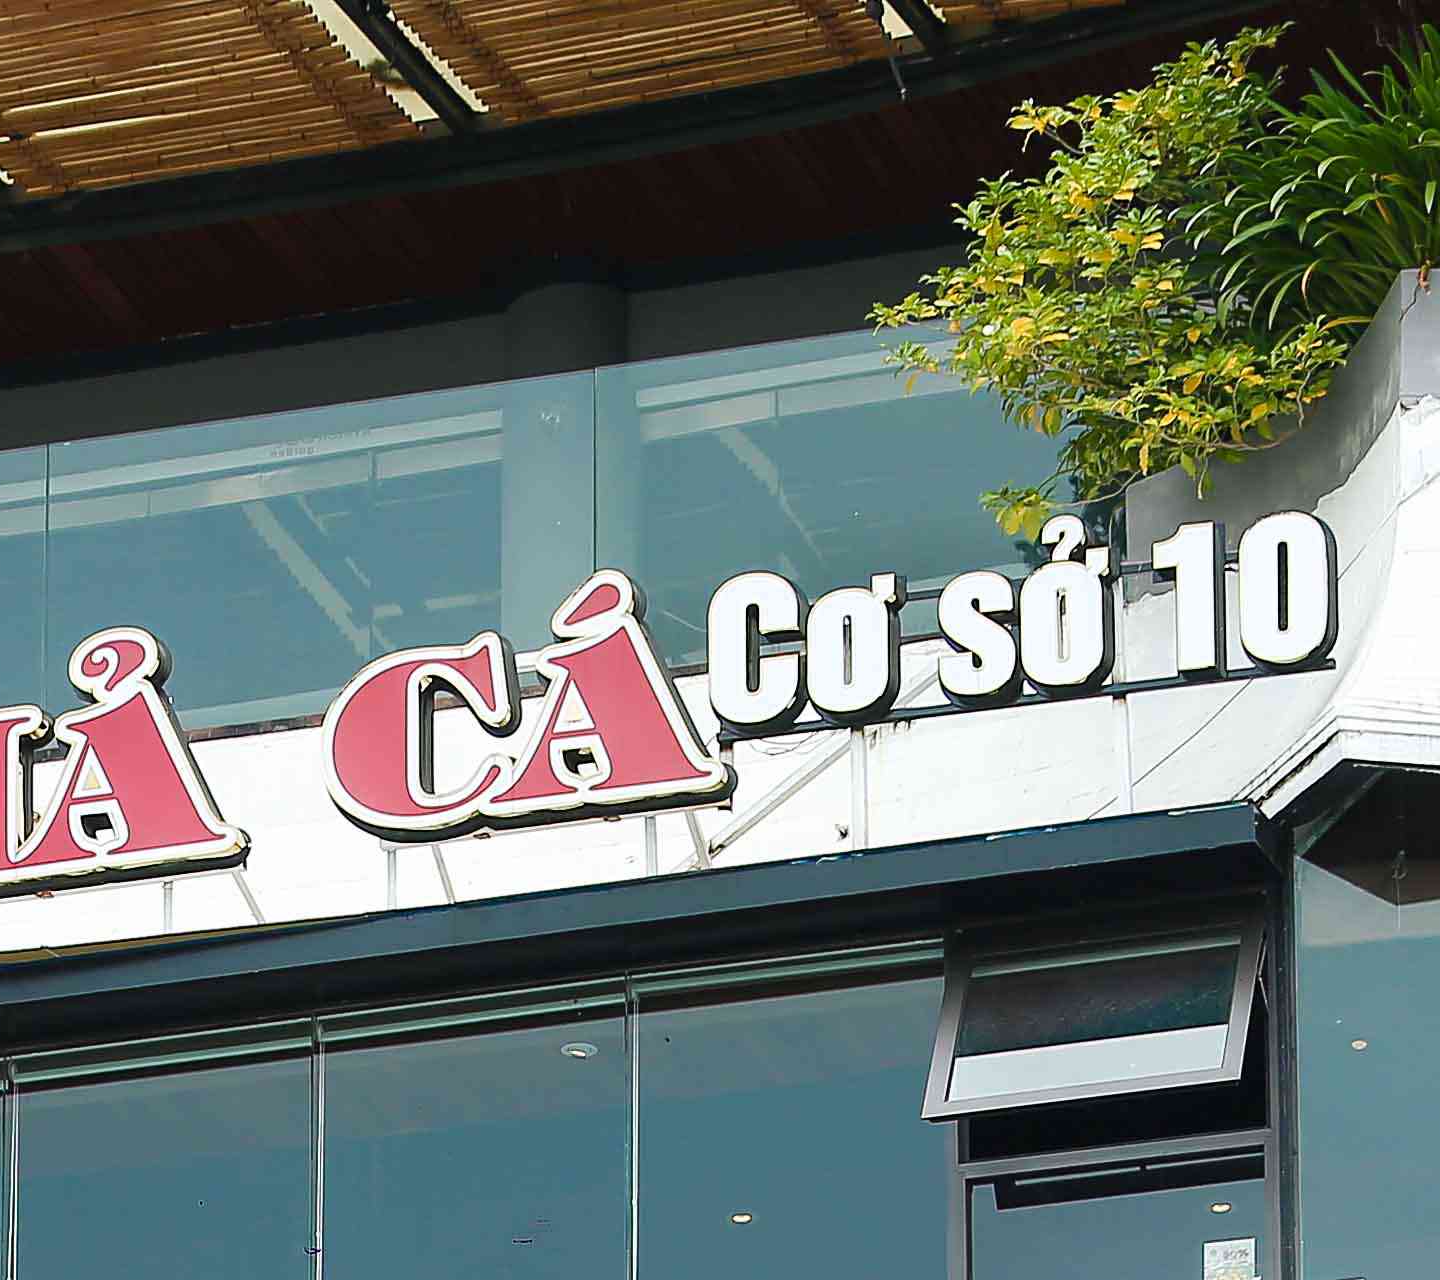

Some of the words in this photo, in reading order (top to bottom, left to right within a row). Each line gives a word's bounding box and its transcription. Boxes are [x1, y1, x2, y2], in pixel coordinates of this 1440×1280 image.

[322, 568, 732, 838] CÁ
[707, 571, 898, 725] Cơ
[1152, 511, 1332, 670] 10
